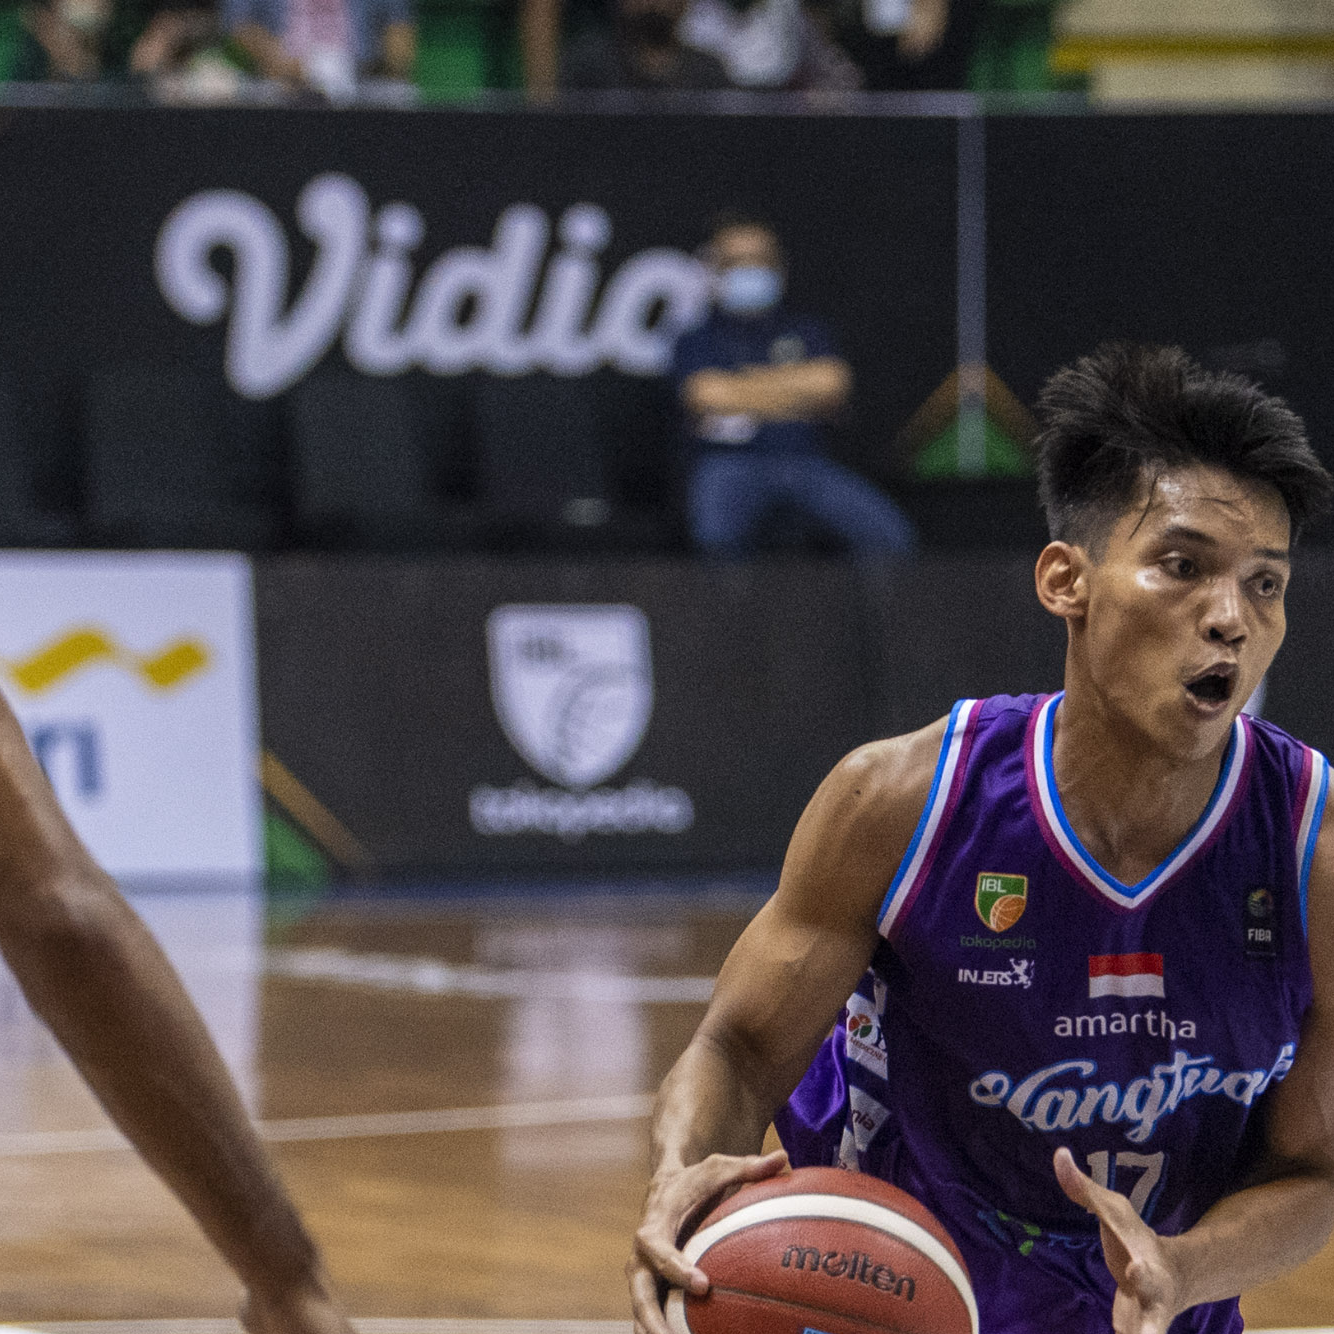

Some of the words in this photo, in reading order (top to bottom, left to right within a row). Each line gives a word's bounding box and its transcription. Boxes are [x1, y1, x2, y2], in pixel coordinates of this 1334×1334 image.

[155, 172, 712, 400] Vidio
[981, 878, 1007, 893] IBL
[960, 934, 1036, 951] tokopedia
[1248, 928, 1272, 942] FIBA
[1054, 1011, 1196, 1040] amartha
[1086, 1150, 1168, 1224] 17
[781, 1244, 916, 1302] molten
